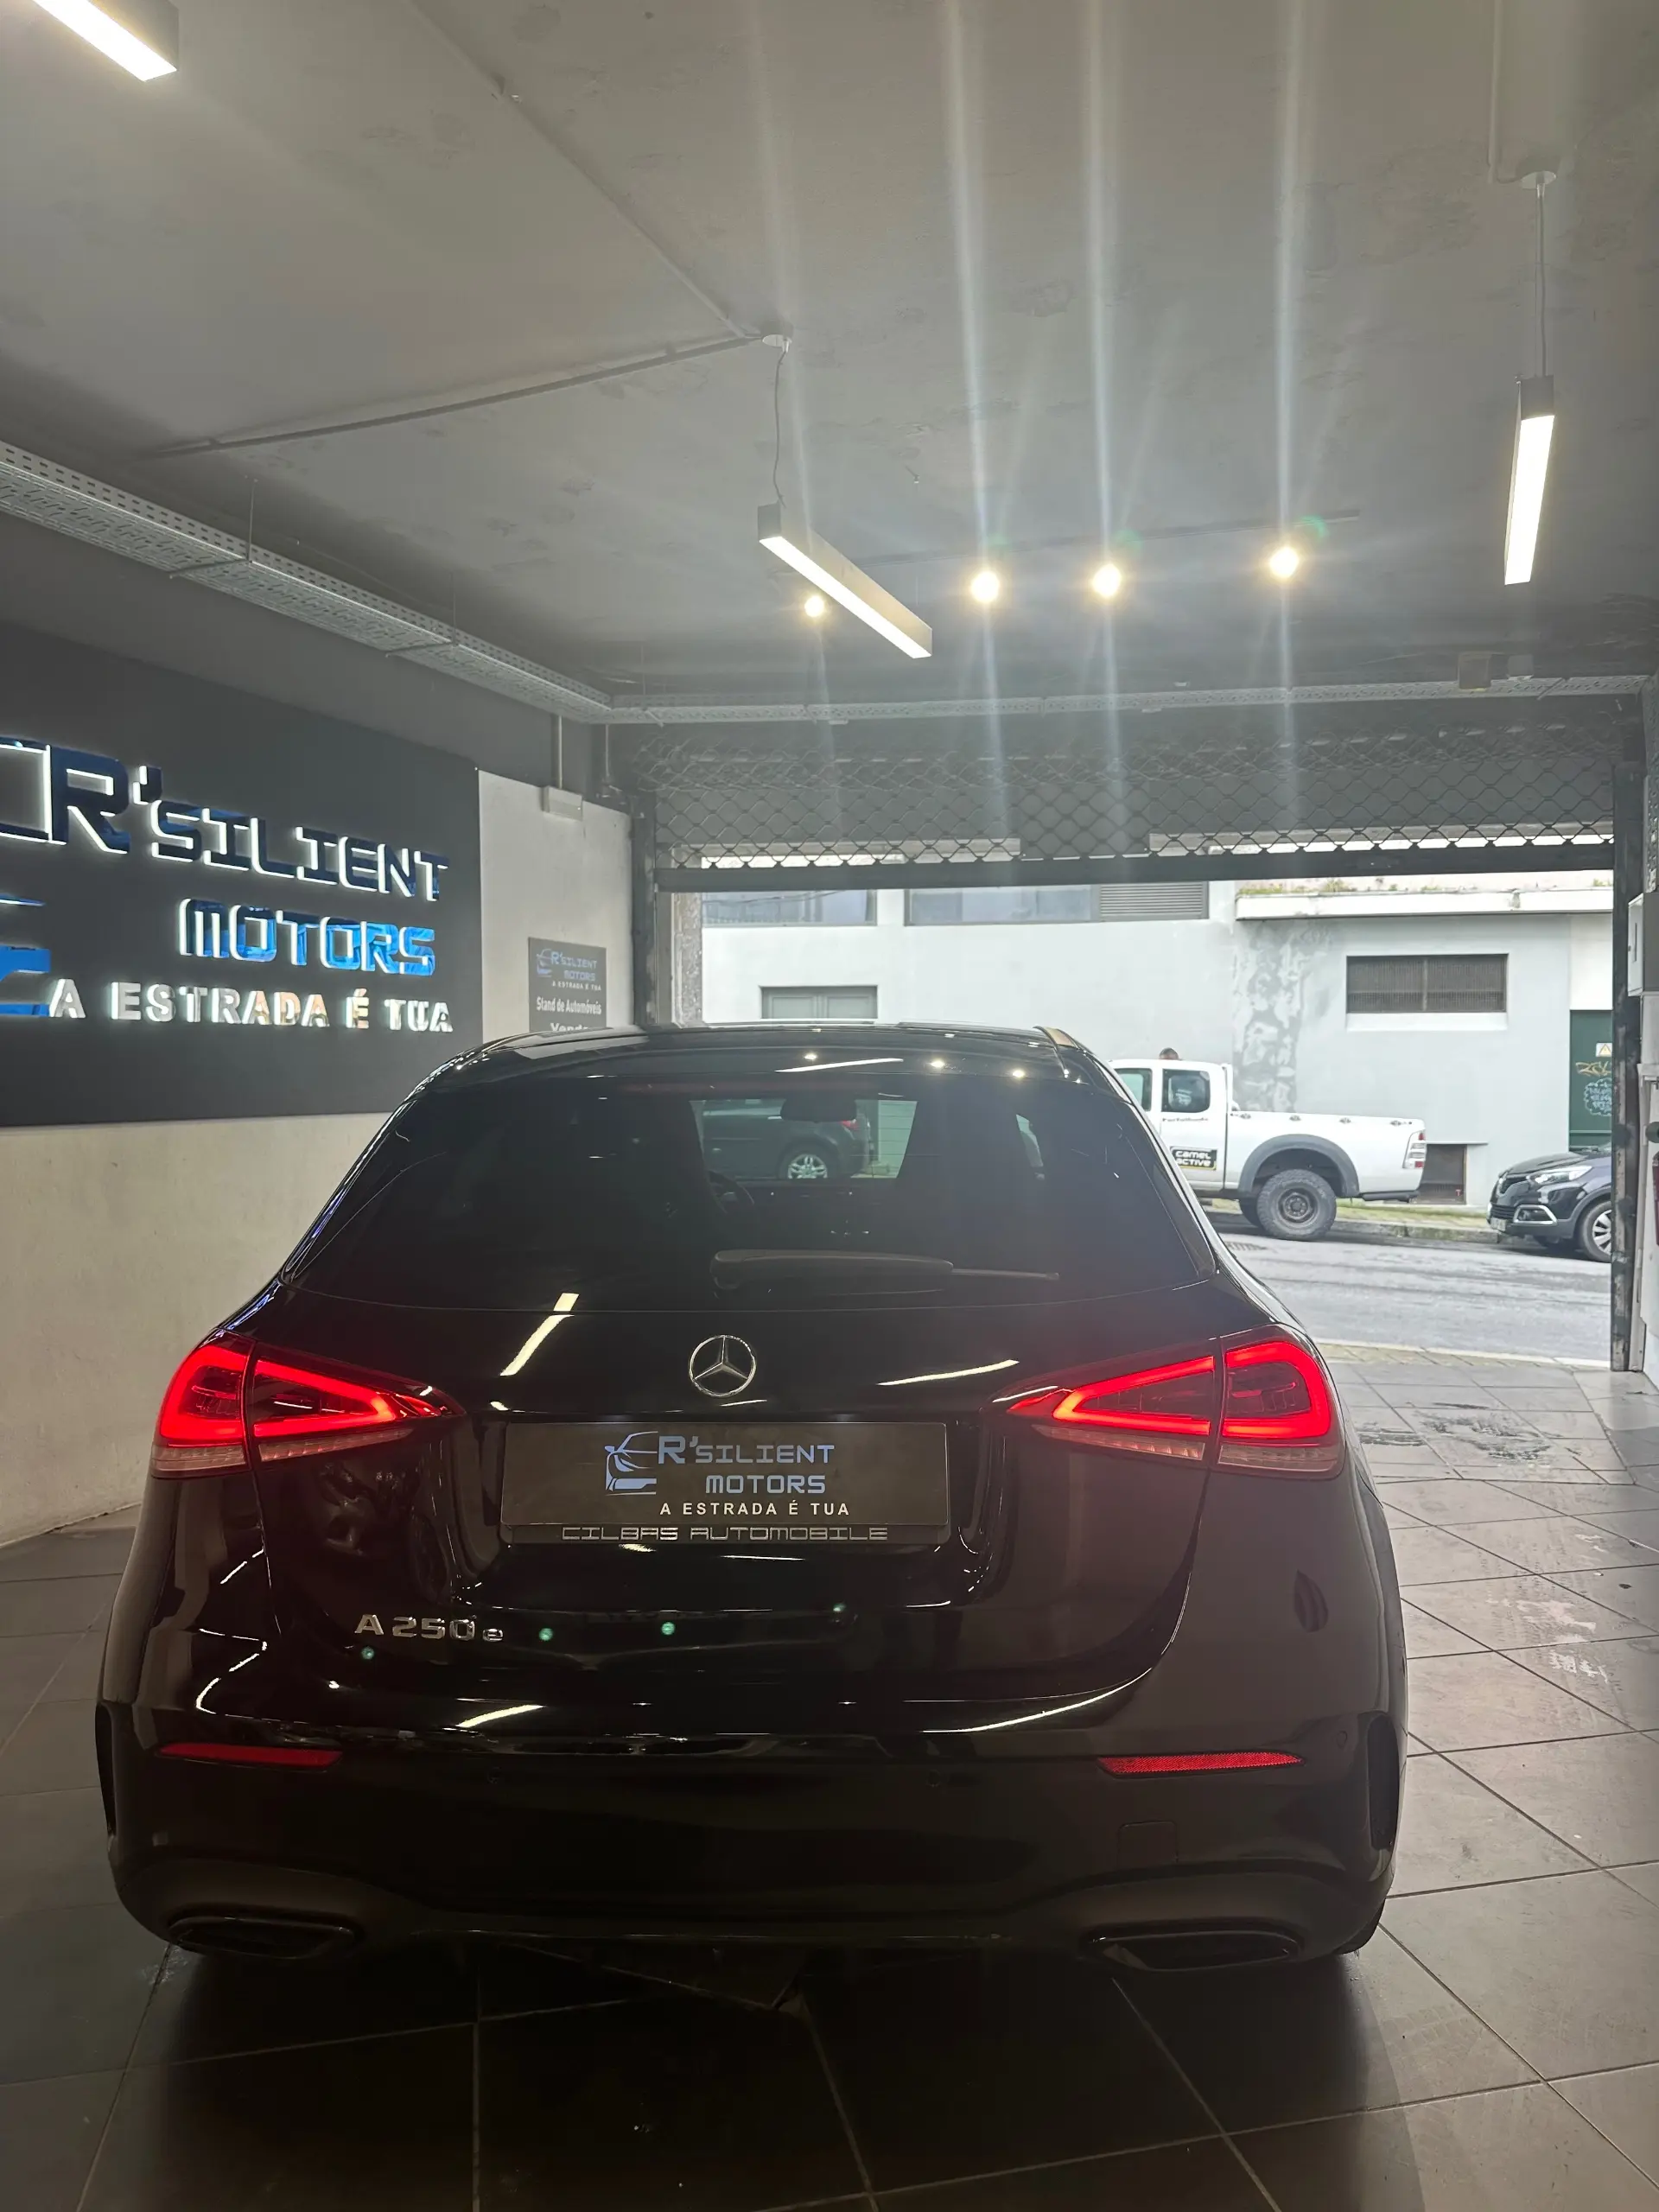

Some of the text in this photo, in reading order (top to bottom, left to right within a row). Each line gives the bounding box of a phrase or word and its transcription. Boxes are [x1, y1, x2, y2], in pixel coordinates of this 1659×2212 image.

[44, 744, 449, 901] R'SILIENT
[179, 898, 435, 976] MOTORS
[558, 981, 584, 989] ESTRADA
[564, 970, 596, 982] MOTORS
[49, 979, 454, 1032] A ESTRADA É TUA
[537, 996, 602, 1015] Stand de Automóveis
[658, 1435, 835, 1464] R'SILIENT
[705, 1475, 826, 1494] MOTORS
[659, 1499, 849, 1516] A ESTRADA É TUA
[562, 1527, 888, 1541] CILBAS AUTOMOBILE
